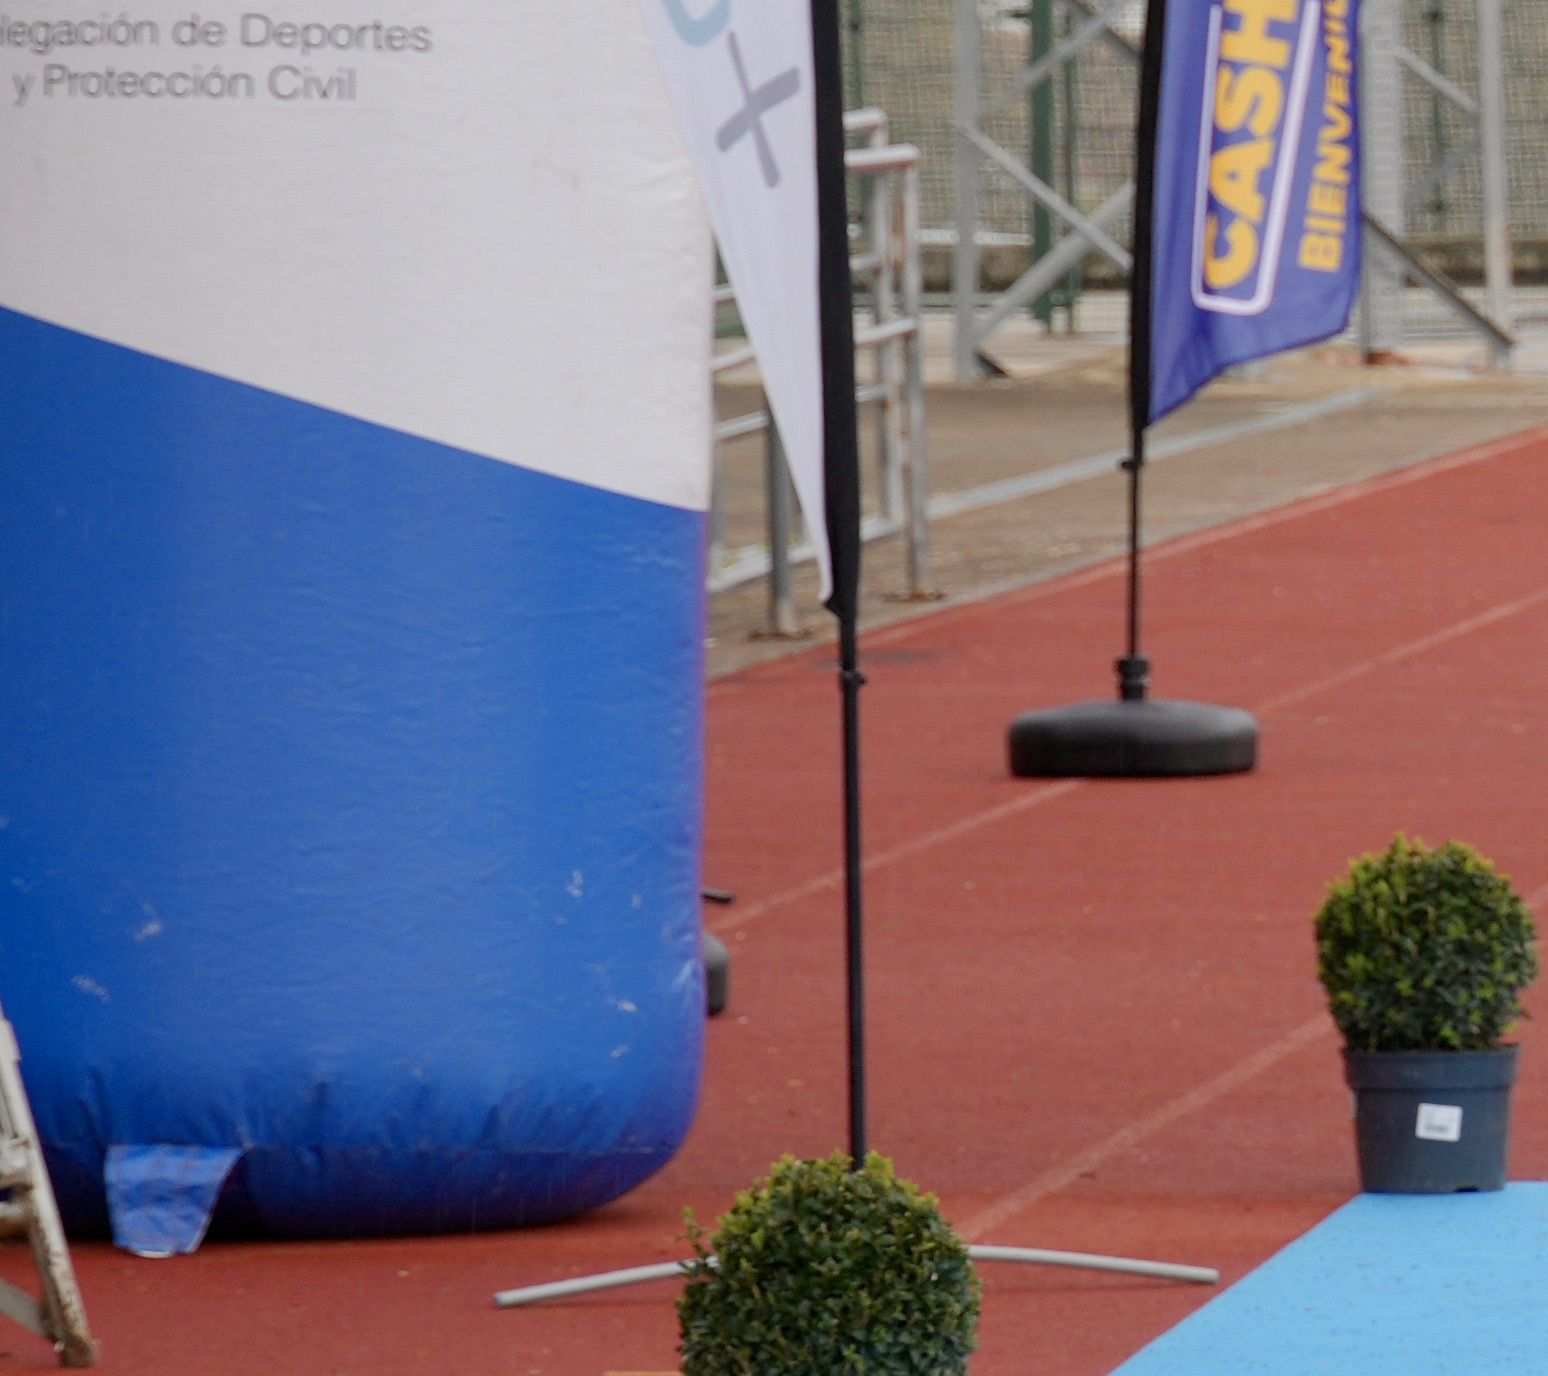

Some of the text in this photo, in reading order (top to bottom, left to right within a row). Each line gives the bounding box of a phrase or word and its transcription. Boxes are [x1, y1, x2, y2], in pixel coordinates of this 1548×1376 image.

[172, 14, 225, 47] de
[240, 13, 434, 55] Deportes
[12, 63, 358, 107] y Protección Civil
